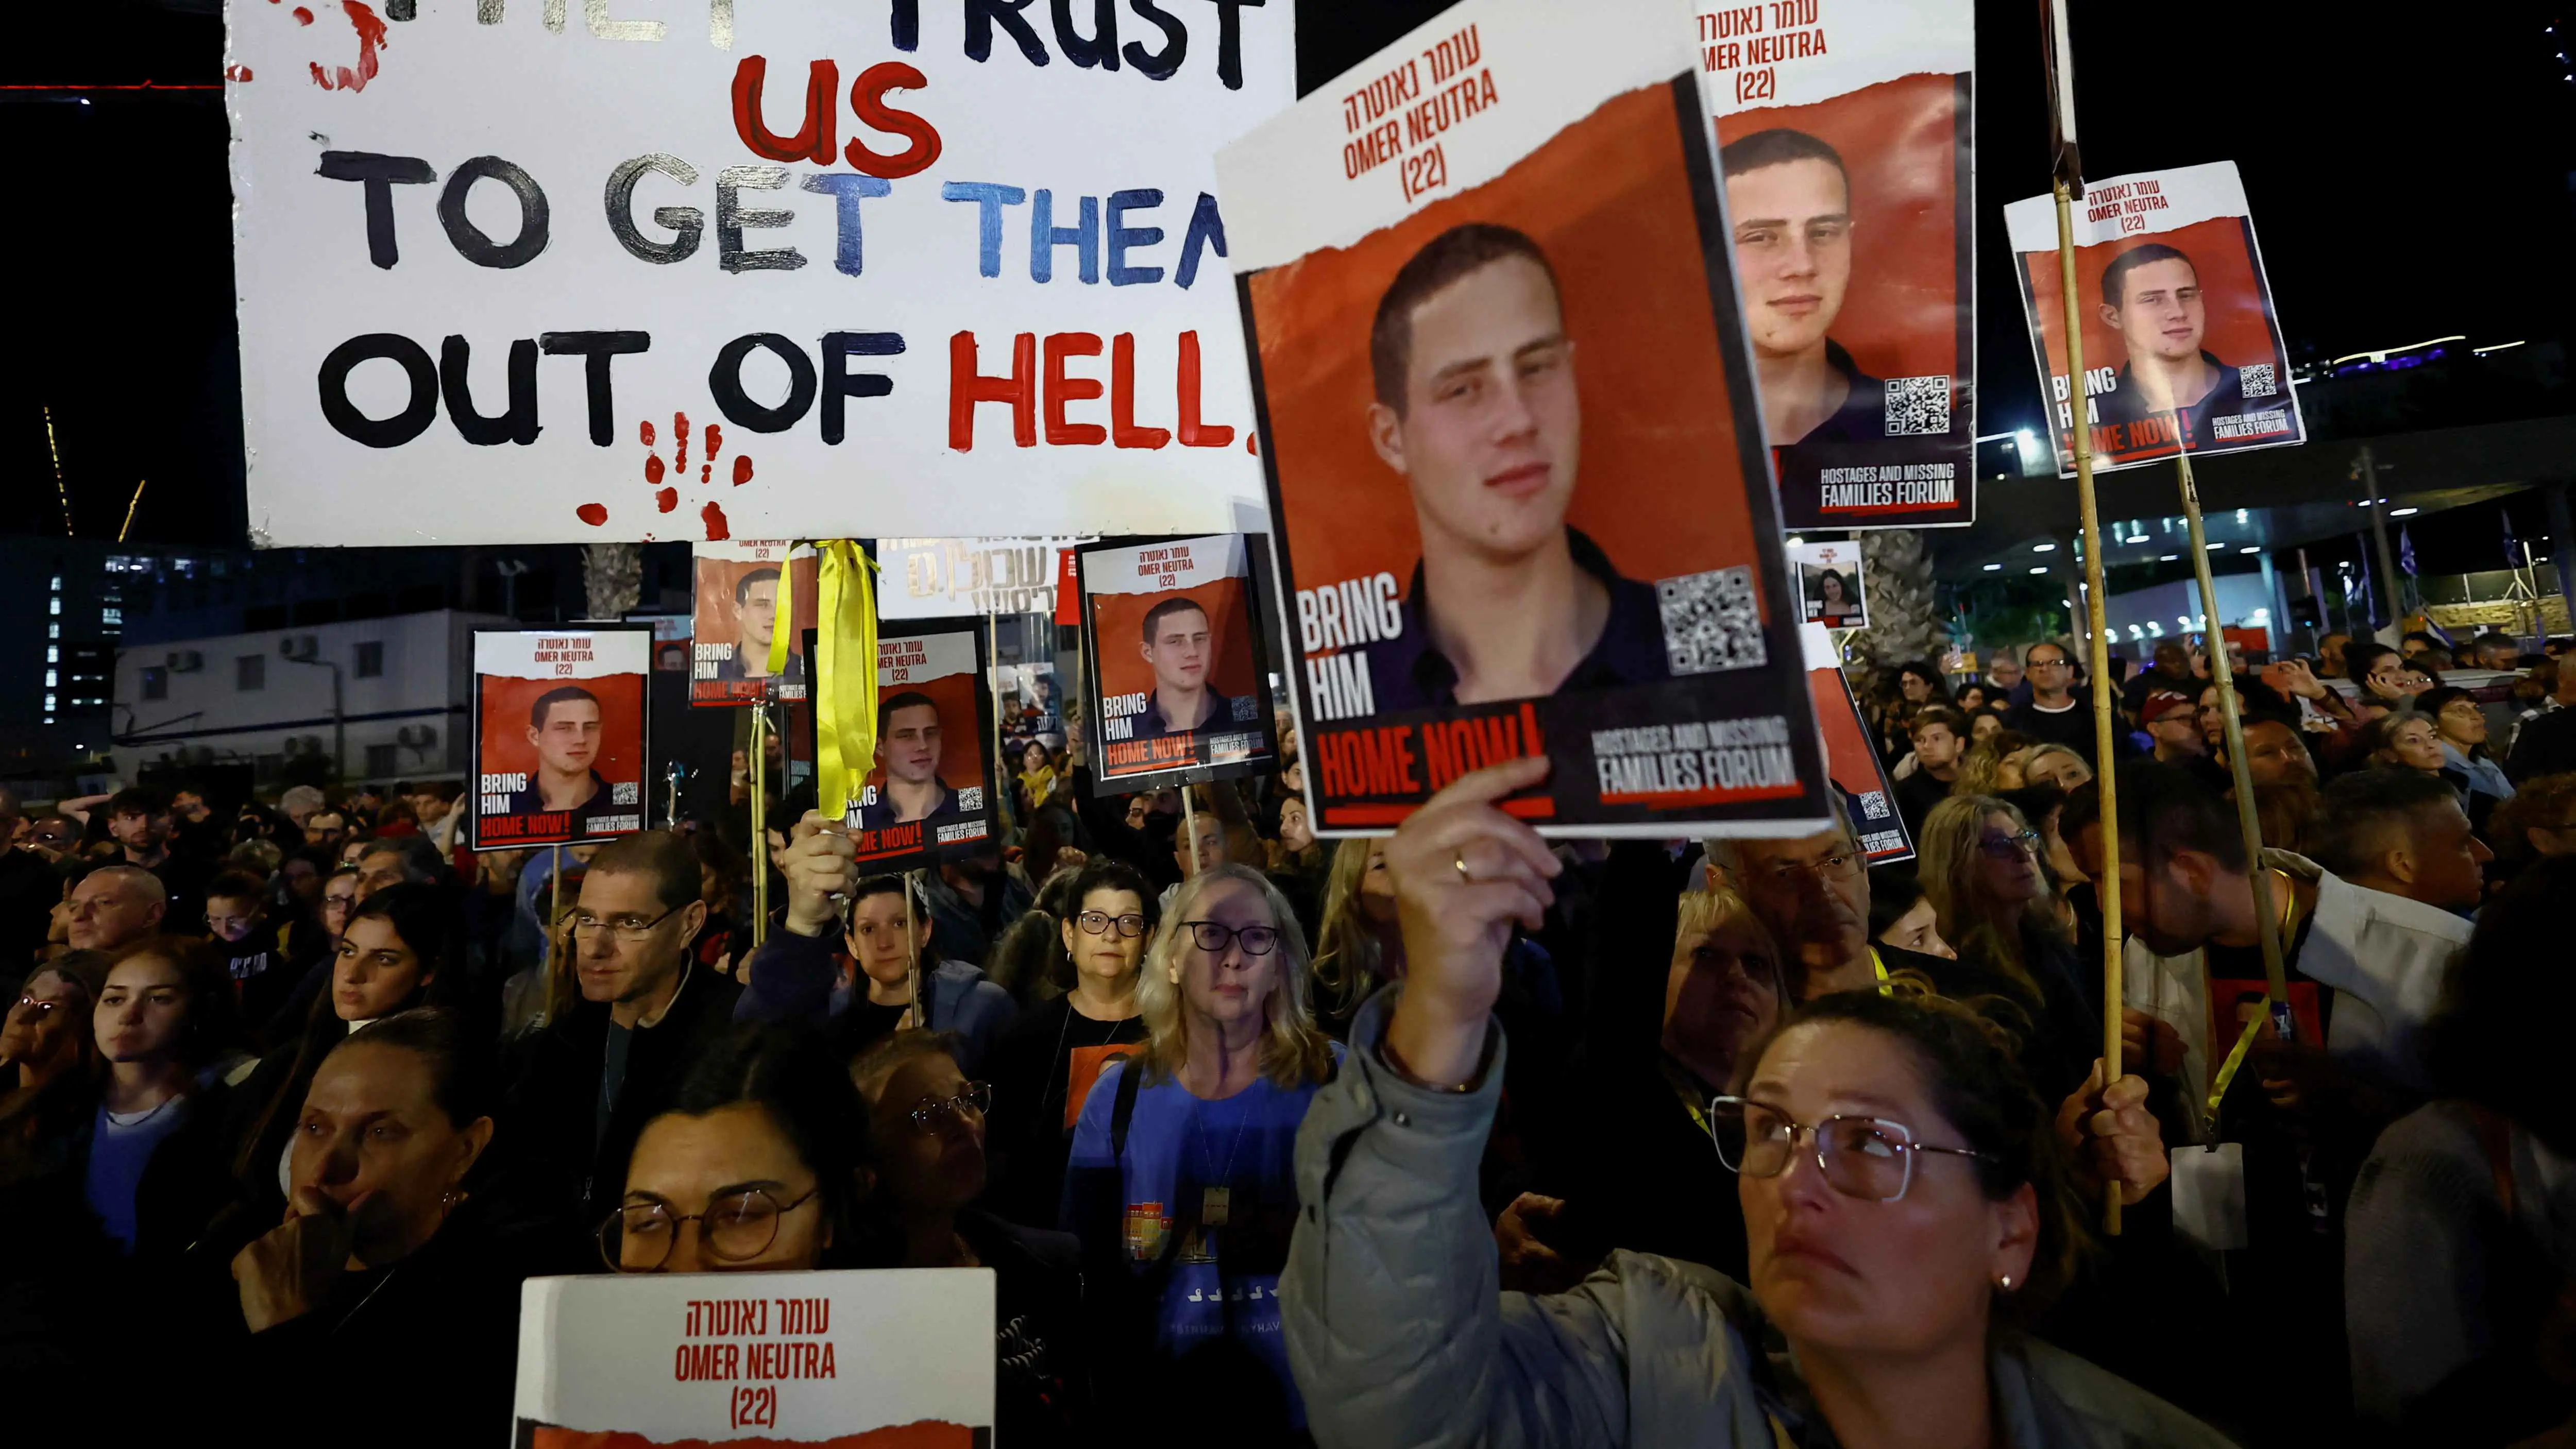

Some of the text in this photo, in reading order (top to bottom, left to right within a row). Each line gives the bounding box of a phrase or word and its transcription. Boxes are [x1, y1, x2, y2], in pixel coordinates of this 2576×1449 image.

[1769, 0, 1818, 29] עומר
[1702, 28, 1827, 72] MER NEUTRA
[1343, 22, 1480, 134] עומר נאוטרה
[1736, 66, 1775, 105] (22)
[731, 55, 942, 179] US
[1344, 67, 1498, 180] OMER NEUTRA
[1401, 142, 1447, 204] (22)
[2088, 180, 2160, 206] עומר נאוטרה
[313, 150, 550, 269] TO
[605, 152, 892, 278] GET
[2088, 195, 2169, 223] OMER NEUTRA
[2121, 214, 2145, 233] (22)
[318, 332, 650, 447] OUT
[708, 330, 906, 446] OF
[2057, 398, 2099, 429] HM
[2212, 414, 2242, 427] HOSTAGES
[2257, 409, 2285, 421] MISSING
[2063, 410, 2193, 459] HME NOW!
[2214, 418, 2289, 439] FAMILIES FORUM
[1821, 463, 1955, 484] HOSTAGES AND MISSING
[1821, 480, 1955, 507] FAMILIES FORUM
[755, 548, 769, 558] (22)
[1139, 547, 1189, 562] עומר נאוטרה
[1138, 558, 1194, 576] OMER NEUTRA
[1159, 574, 1175, 588] (22)
[1296, 572, 1403, 653] BRING
[535, 651, 594, 662] OMER NEUTRA
[538, 638, 591, 650] עומר נאוטרה
[695, 643, 732, 661] BRING
[877, 641, 923, 655] עומר נאוטר
[556, 663, 572, 676] (22)
[694, 661, 718, 679] HIM
[877, 653, 927, 670] MER NEUTRA
[892, 668, 908, 682] (22)
[1306, 650, 1375, 721] HIM
[693, 681, 728, 699] HOME
[1103, 692, 1146, 718] BRING
[1106, 717, 1133, 741] HIM
[1108, 730, 1195, 765] HOME NOW!
[1211, 742, 1239, 755] FAMILIES
[1317, 726, 1420, 797] HOME
[1598, 745, 1796, 795] FAMILIES FORUM
[481, 773, 527, 794] BRING
[481, 794, 510, 815] HIM
[480, 811, 570, 837] HOME NOW!
[586, 821, 639, 833] FAMILIES FORUM
[846, 809, 863, 829] IM
[882, 820, 922, 849] NOW!
[938, 827, 987, 843] FAMILIES FORUM
[1880, 837, 1904, 851] FORUM
[686, 1298, 829, 1337] עומר נאוטרה
[675, 1342, 836, 1381] OMER NEUTRA
[730, 1385, 776, 1429] (22)
